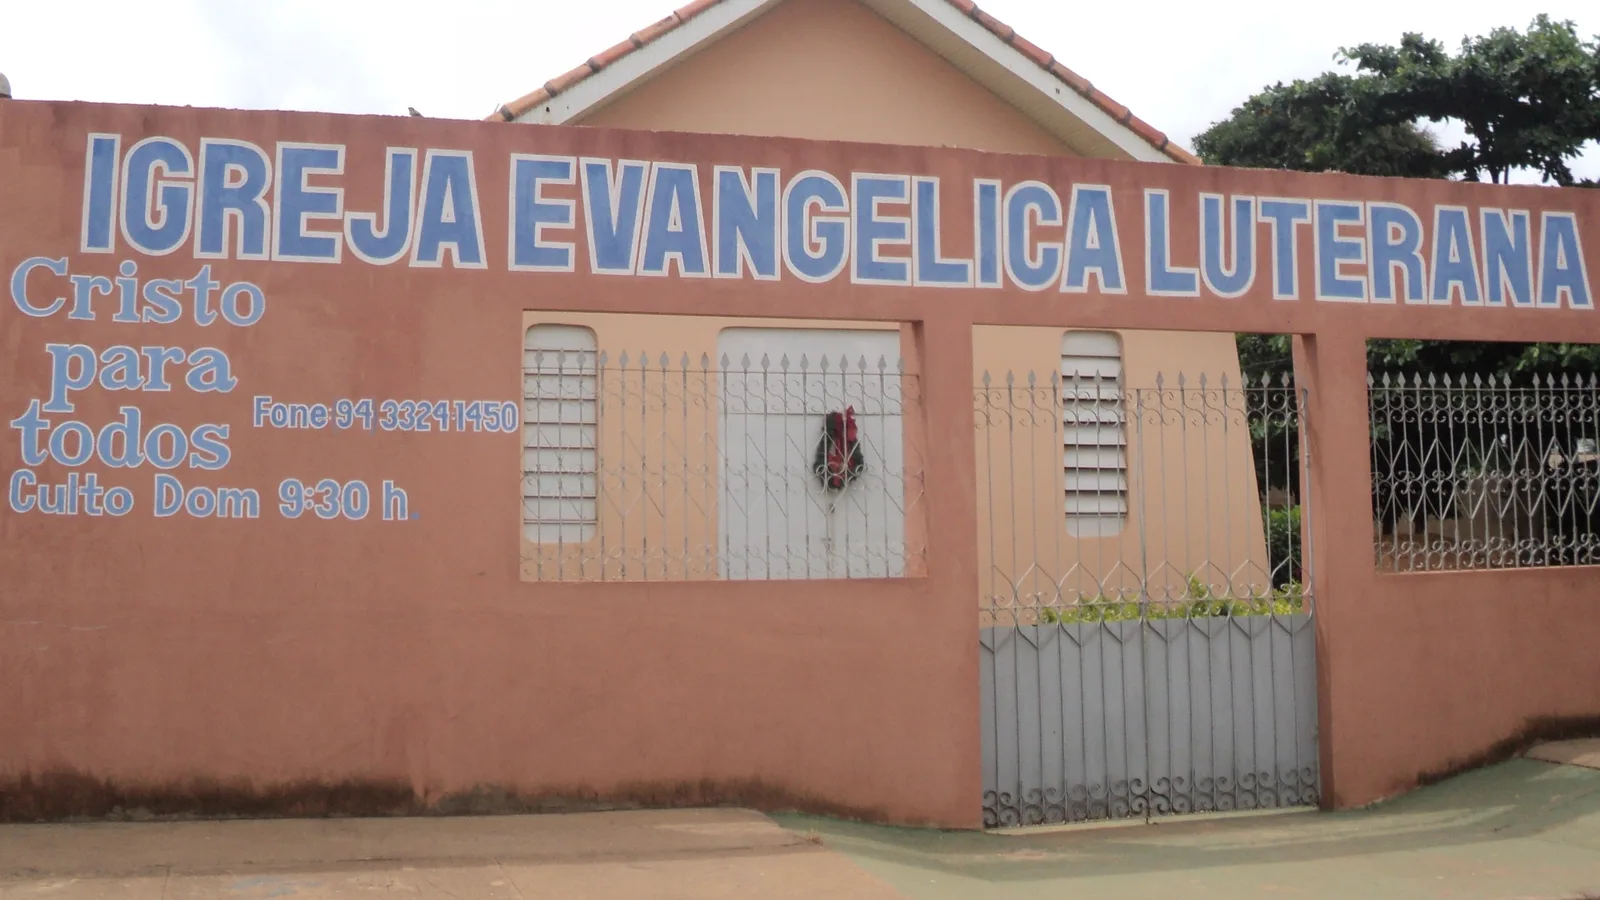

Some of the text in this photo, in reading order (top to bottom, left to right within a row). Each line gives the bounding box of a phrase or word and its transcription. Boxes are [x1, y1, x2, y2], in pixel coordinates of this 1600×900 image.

[80, 132, 1595, 310] IGREJA EVANGELICA LUTERANA
[9, 256, 266, 327] Cristo
[43, 343, 238, 413] para
[10, 399, 232, 470] todos
[9, 469, 135, 516] Culto
[153, 474, 260, 518] Dom
[278, 478, 371, 520] 9:30
